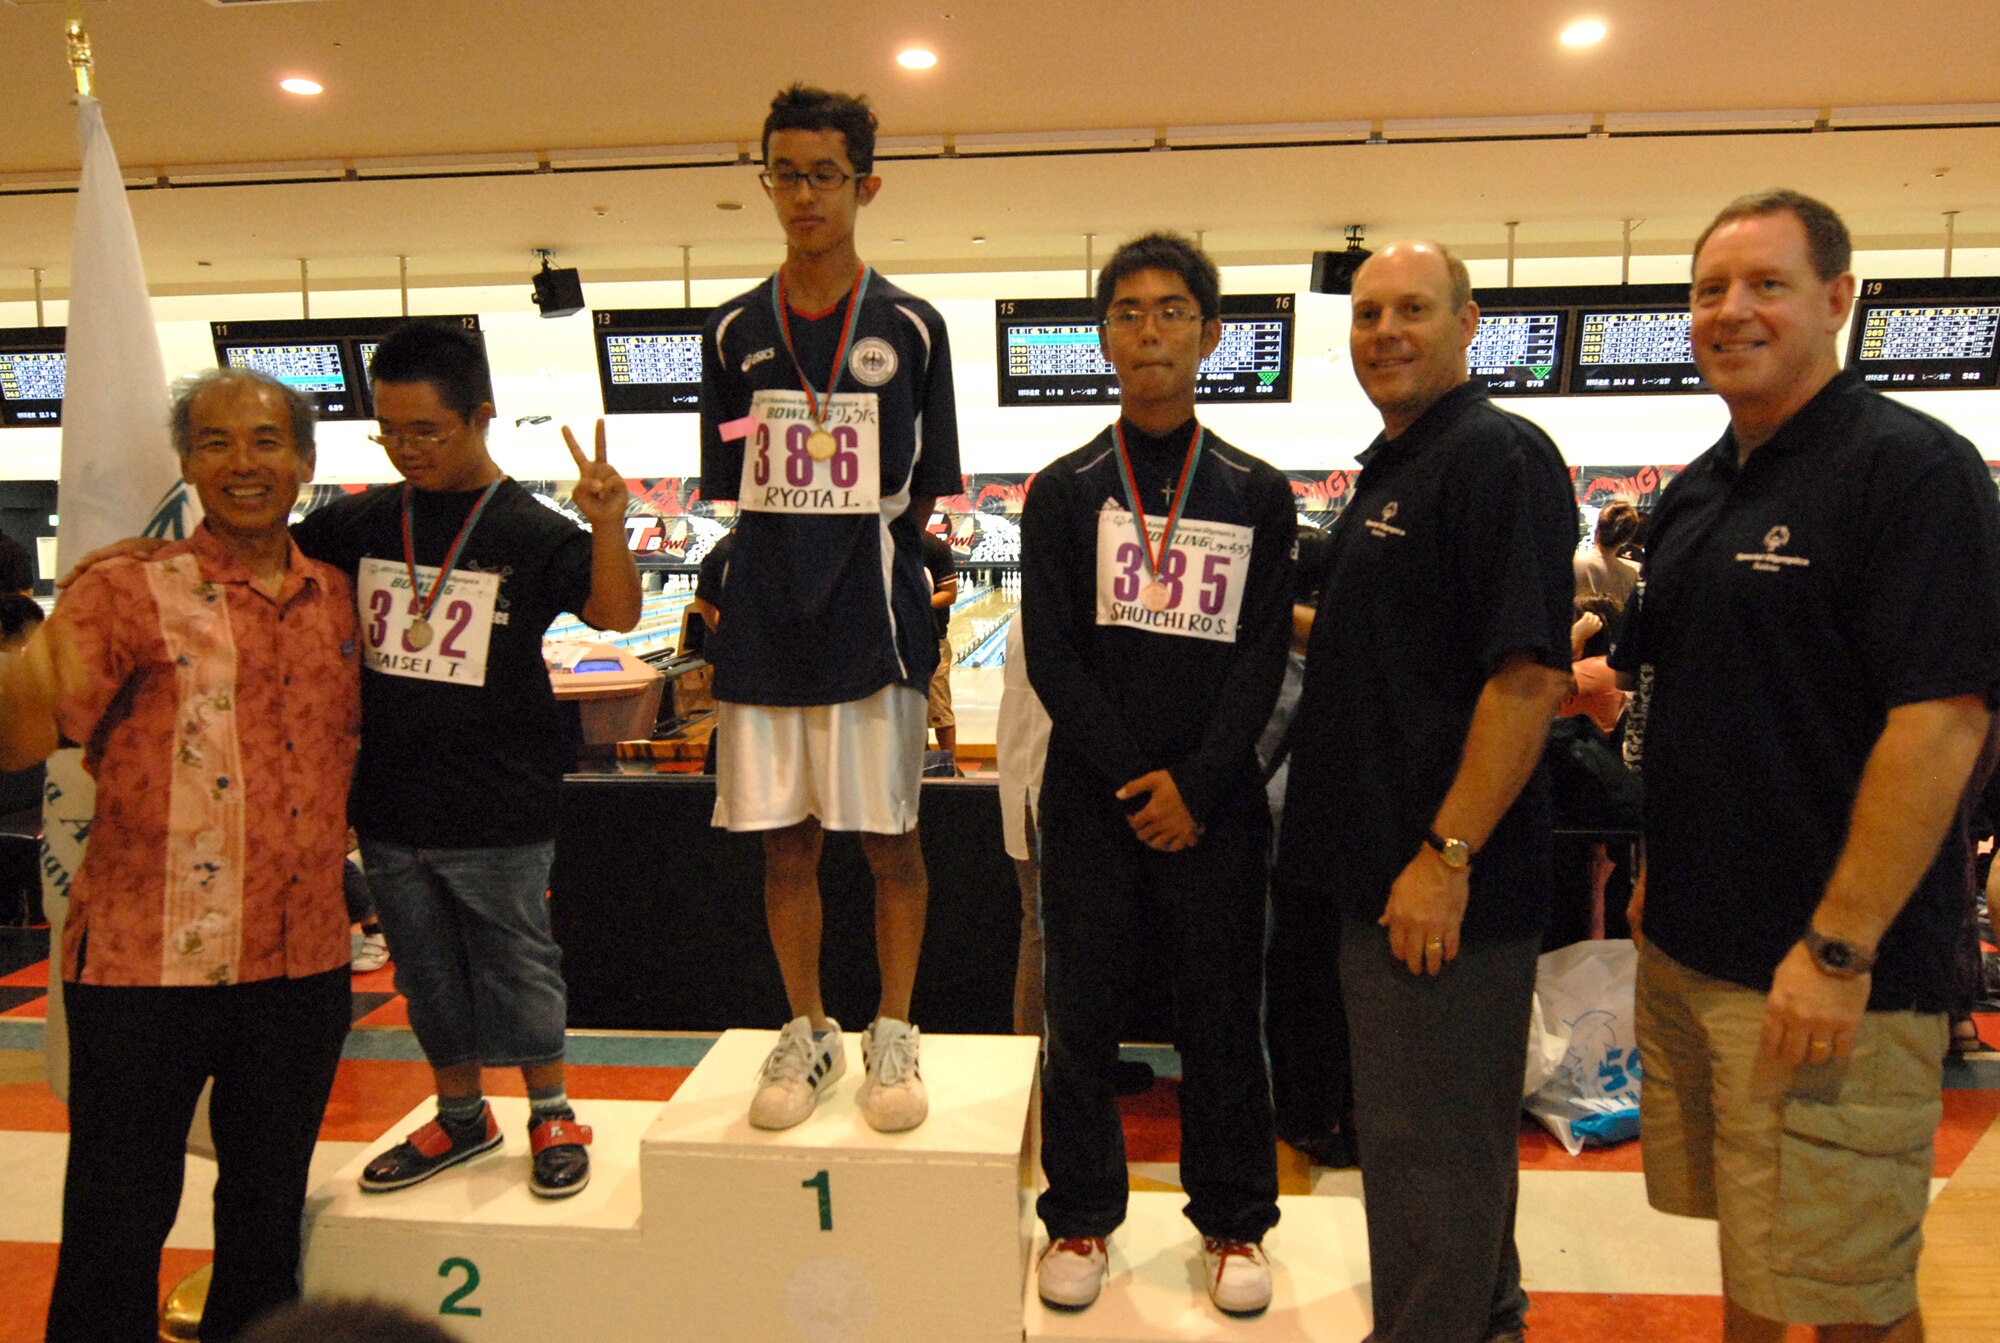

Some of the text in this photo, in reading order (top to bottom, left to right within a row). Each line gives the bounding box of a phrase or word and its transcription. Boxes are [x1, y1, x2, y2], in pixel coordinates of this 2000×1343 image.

[1867, 283, 1882, 295] 19
[1000, 303, 1015, 315] 15
[1275, 297, 1290, 309] 16
[461, 318, 475, 329] 12
[597, 313, 611, 324] 13
[215, 325, 228, 336] 11
[754, 423, 859, 488] 386
[764, 486, 834, 508] RYOTA
[1113, 542, 1231, 616] 385
[1111, 602, 1212, 632] SHUICHIRO
[374, 651, 432, 674] TAISEI
[801, 1170, 833, 1232] 1
[437, 1256, 482, 1317] 2
